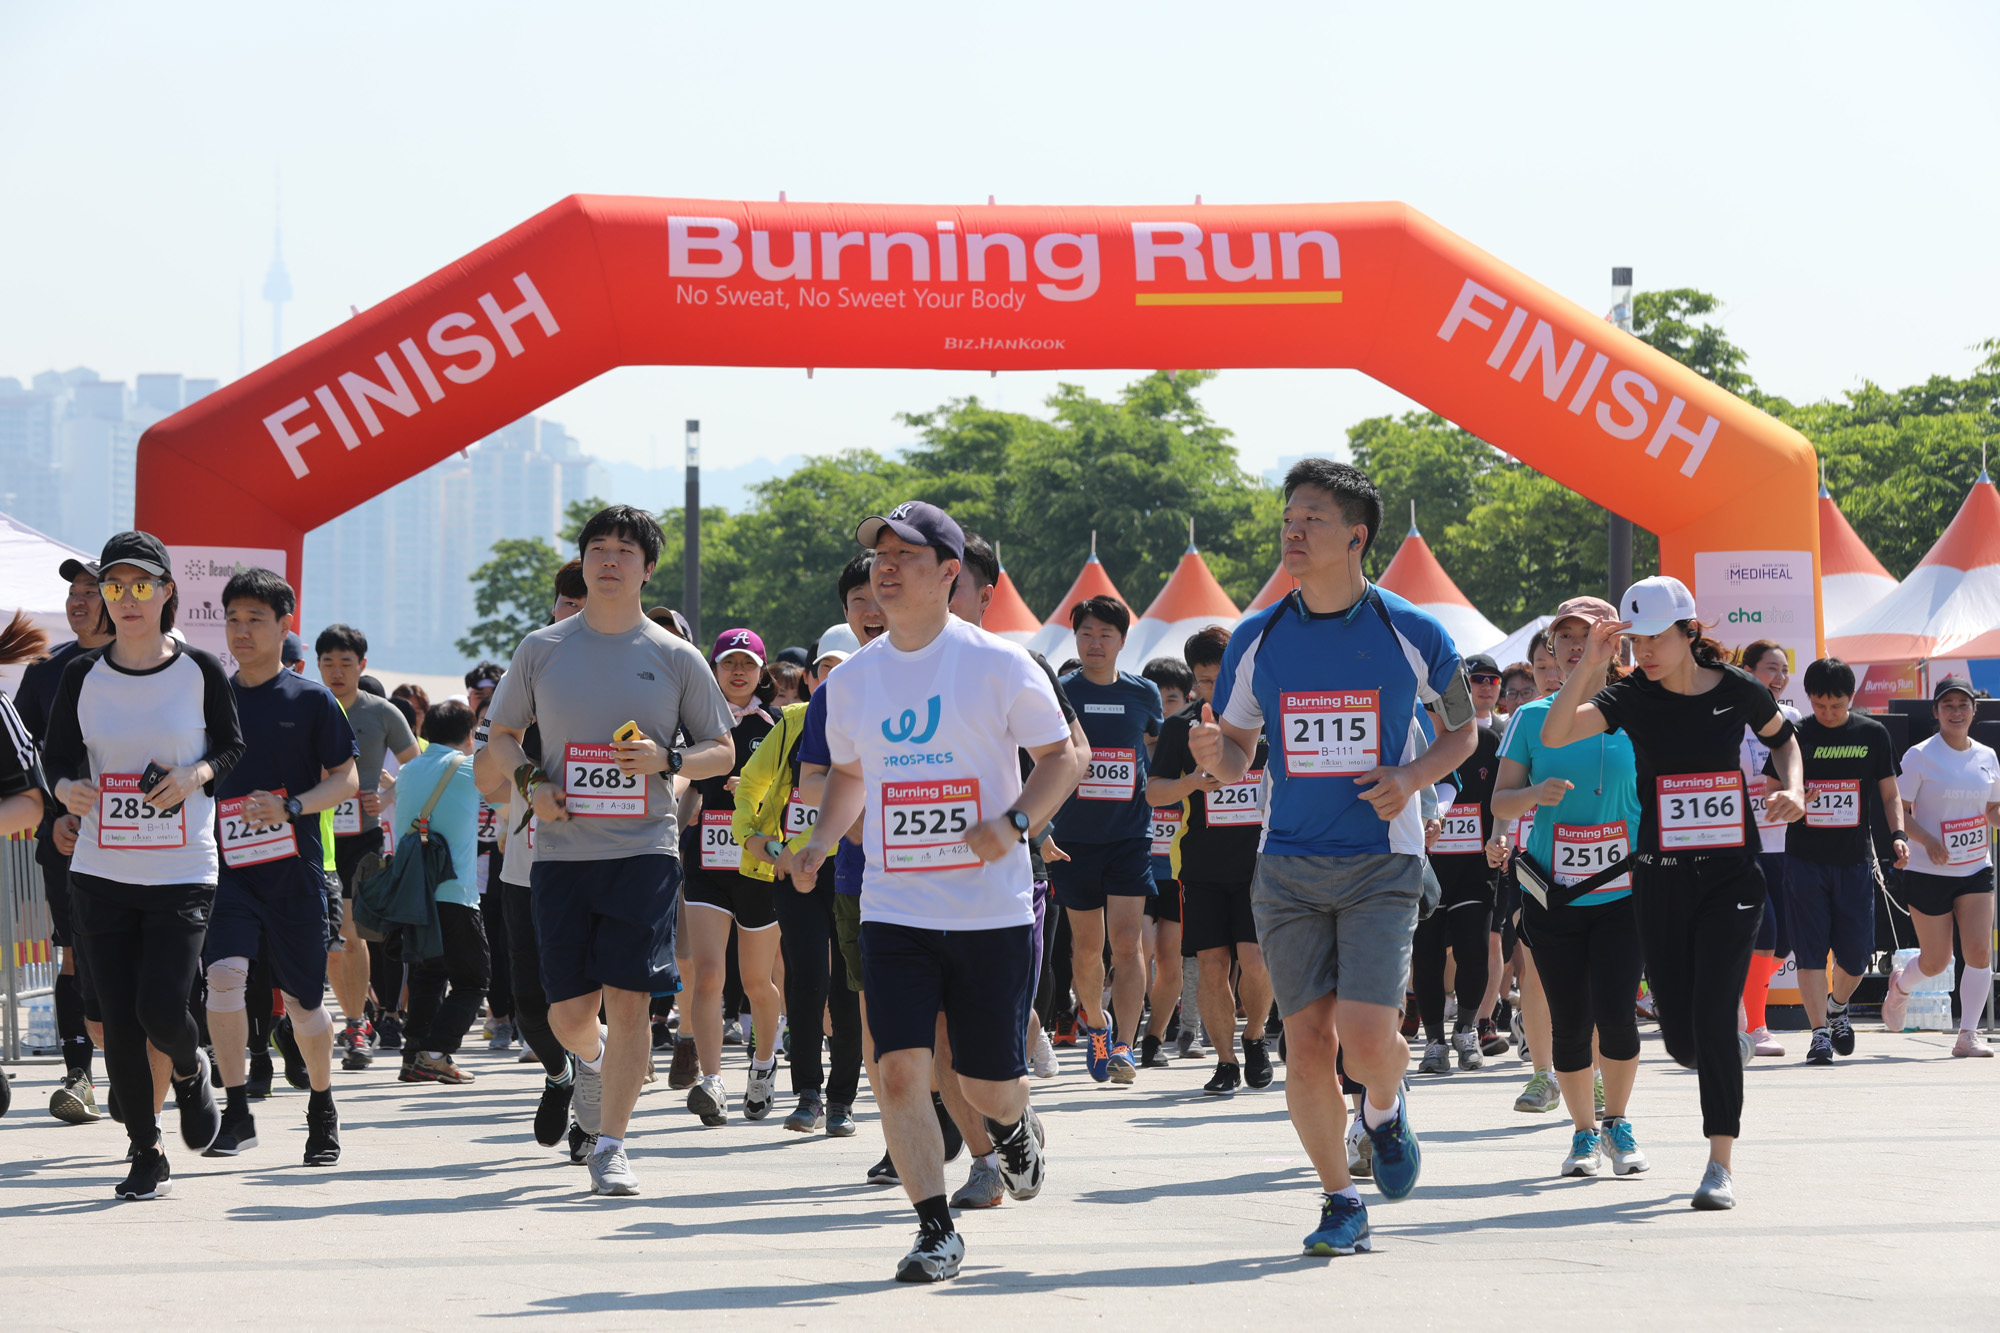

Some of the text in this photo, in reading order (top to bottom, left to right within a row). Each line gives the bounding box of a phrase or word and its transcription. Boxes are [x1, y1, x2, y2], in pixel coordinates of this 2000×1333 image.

[667, 216, 1342, 302] Burning Run
[676, 285, 1026, 311] No Sweat, No Sweet Your Body
[262, 271, 561, 480] FINISH
[1436, 278, 1721, 479] FINISH
[1730, 568, 1793, 580] MEDIHEAL
[1865, 678, 1914, 692] Burning Run
[1287, 695, 1372, 708] Burning Run
[1293, 717, 1366, 743] 2115
[1321, 746, 1353, 757] B-111
[1813, 745, 1869, 759] RUNNING
[883, 752, 953, 767] PROSPECS
[106, 777, 140, 787] Burnin
[1245, 772, 1262, 780] Run
[1663, 776, 1738, 789] Burning Run
[887, 784, 972, 799] Burning Run
[1808, 782, 1840, 790] Burning
[1213, 787, 1258, 805] 2261
[1812, 794, 1854, 809] 3124
[334, 801, 354, 816] 22
[1670, 795, 1735, 820] 3166
[1751, 797, 1768, 812] 20
[704, 813, 732, 821] Burnin
[793, 807, 819, 826] 30
[892, 808, 967, 836] 2525
[1164, 811, 1180, 819] Run
[1154, 824, 1176, 838] 59
[1441, 819, 1476, 835] 126
[1558, 826, 1623, 839] Burning Run
[1944, 820, 1974, 830] Burning
[706, 828, 740, 847] 308
[1950, 829, 1983, 848] 2023
[1561, 843, 1621, 868] 2516
